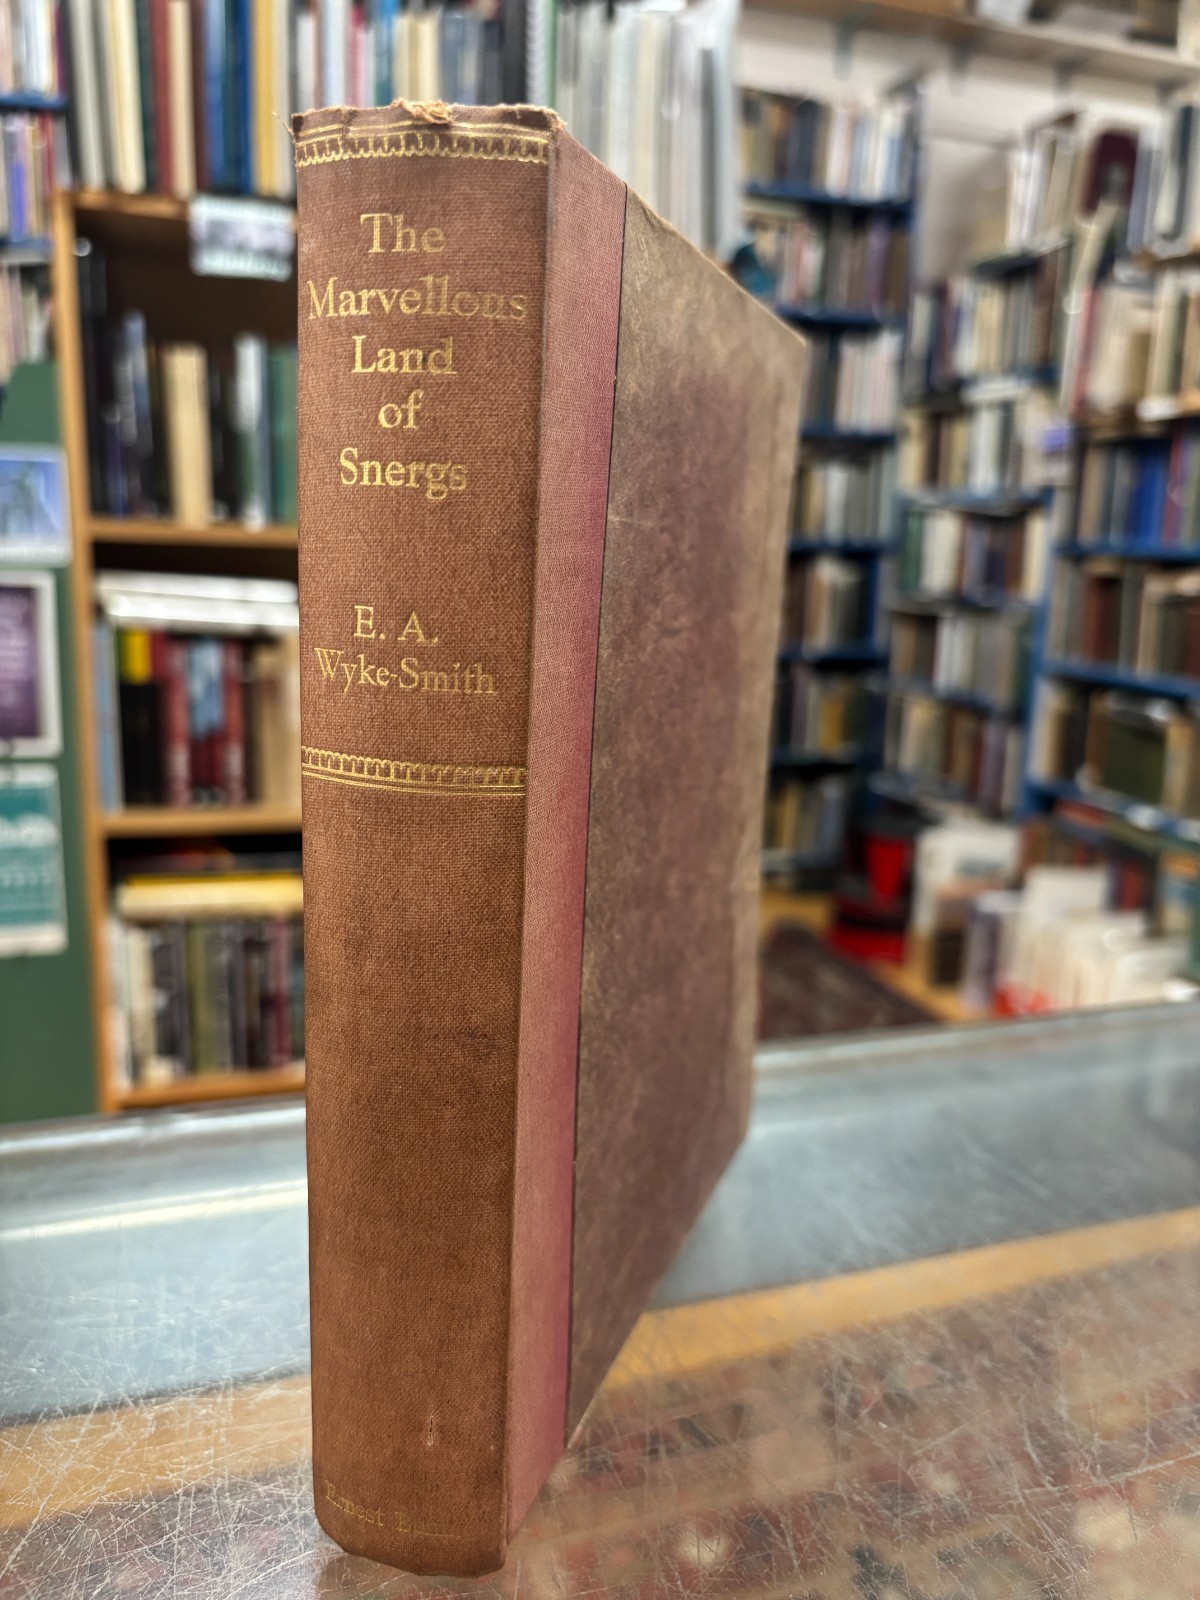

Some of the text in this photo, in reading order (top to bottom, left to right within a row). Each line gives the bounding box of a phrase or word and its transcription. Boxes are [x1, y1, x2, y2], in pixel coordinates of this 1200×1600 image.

[361, 212, 446, 253] The
[307, 276, 528, 320] Marvellous
[351, 335, 457, 375] Land
[378, 389, 423, 430] of
[339, 447, 468, 500] Snergs
[353, 605, 439, 643] E. A.
[313, 647, 495, 694] Wyke-Smith
